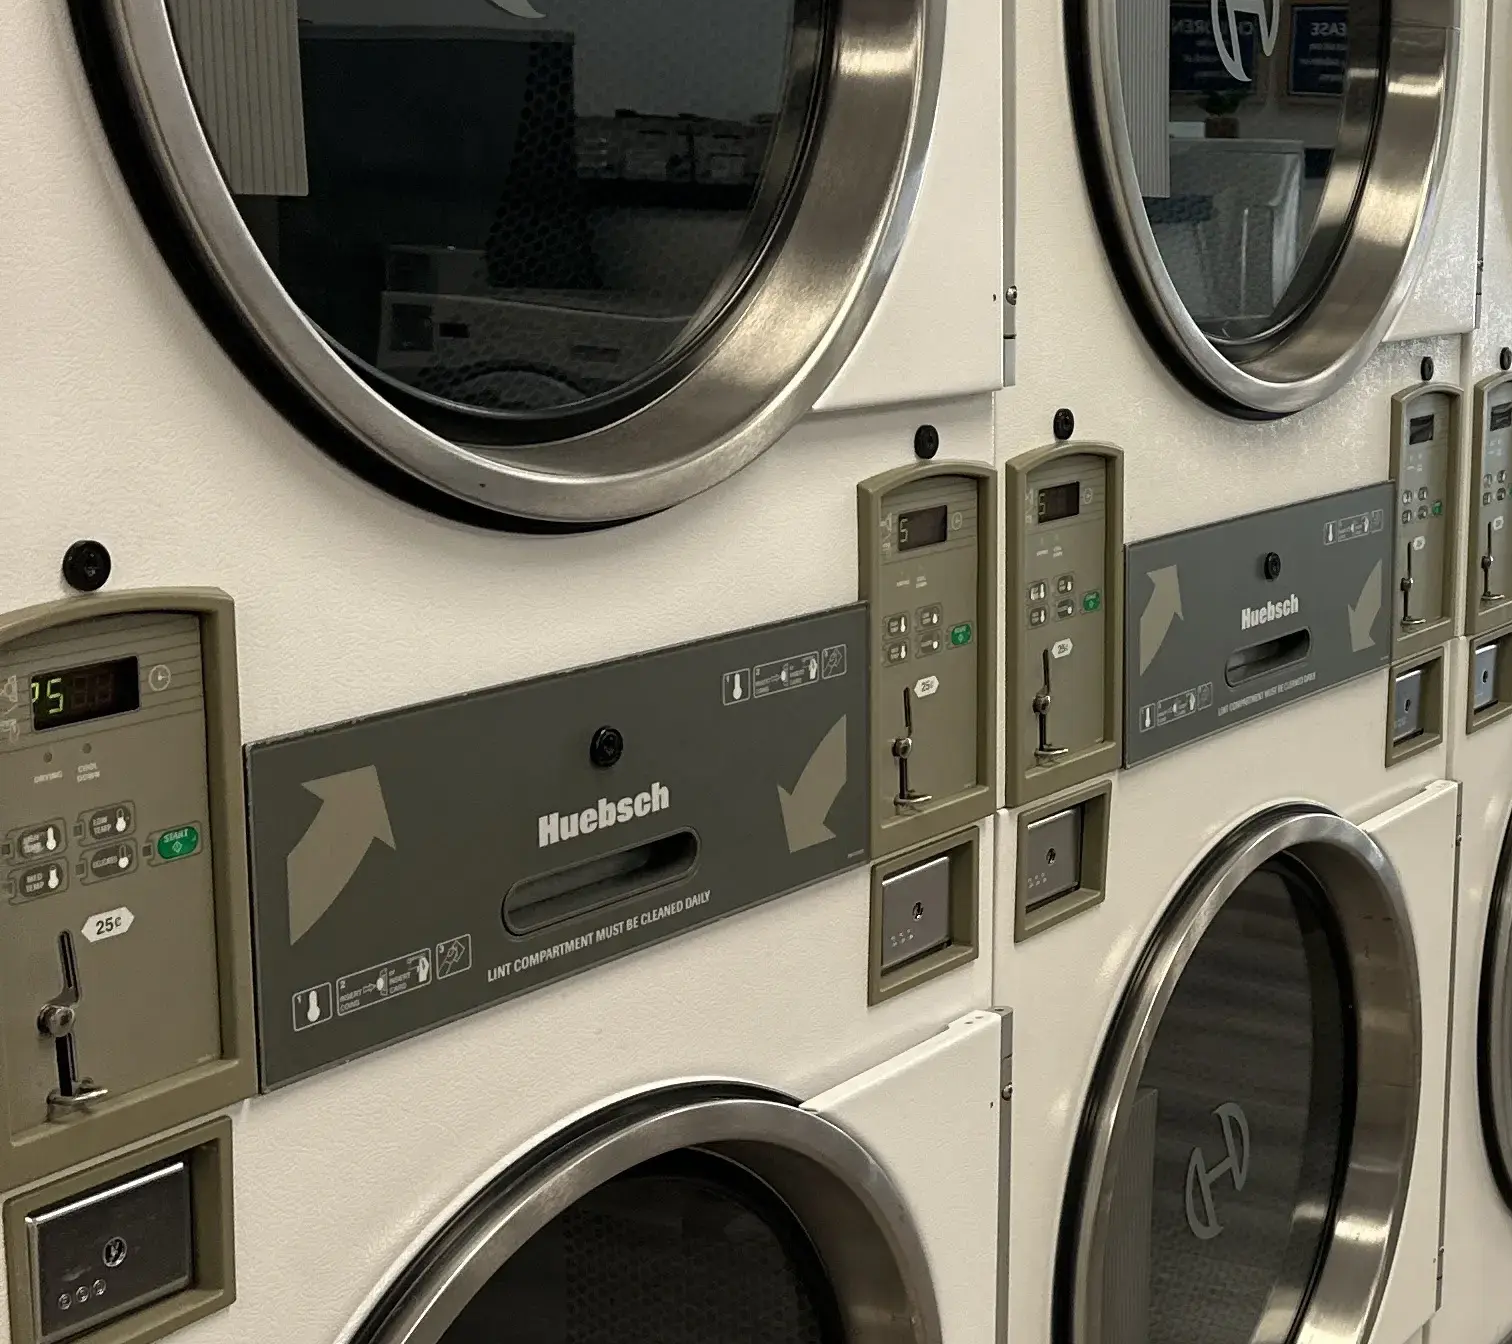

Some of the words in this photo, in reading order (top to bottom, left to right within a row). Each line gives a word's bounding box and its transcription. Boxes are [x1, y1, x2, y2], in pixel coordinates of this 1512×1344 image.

[1241, 593, 1300, 631] Huebsch
[163, 828, 189, 843] START
[538, 781, 670, 848] Huebsch
[487, 962, 513, 983] LINT
[514, 932, 593, 973] COMPARTMENT
[596, 922, 625, 942] MUST
[626, 918, 639, 931] BE
[640, 900, 684, 926] CLEANED
[685, 889, 711, 910] DAILY
